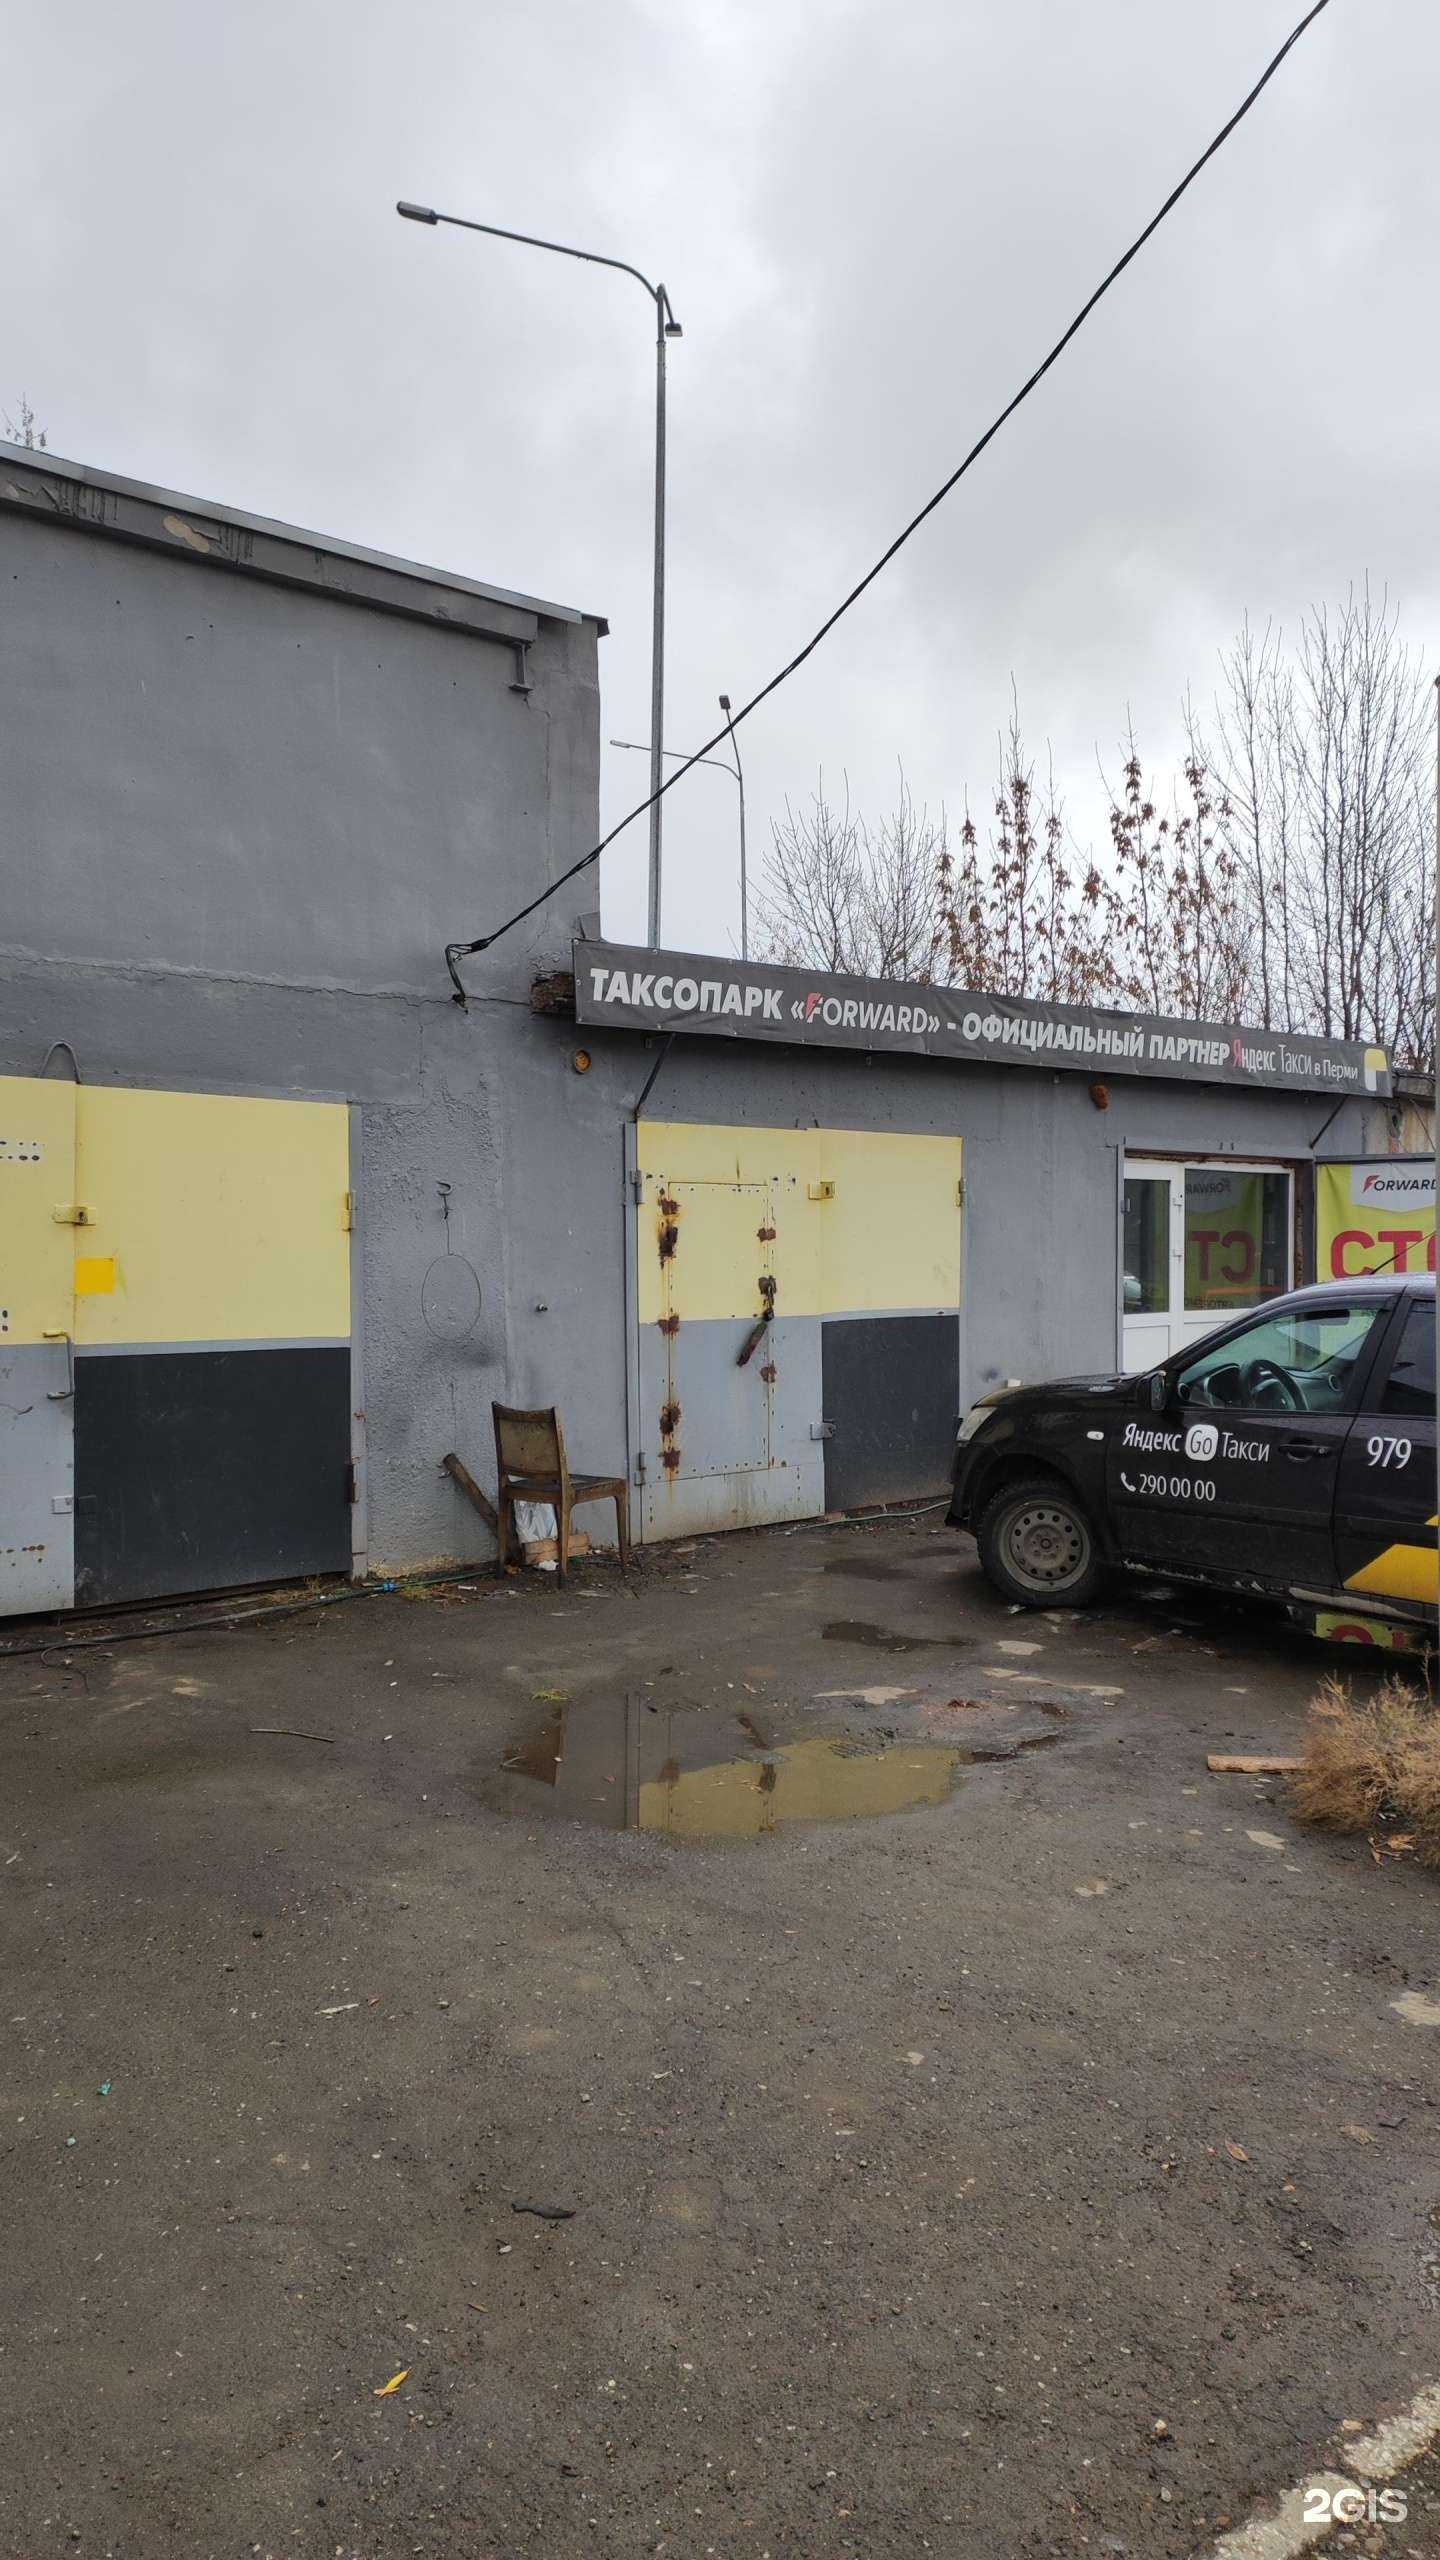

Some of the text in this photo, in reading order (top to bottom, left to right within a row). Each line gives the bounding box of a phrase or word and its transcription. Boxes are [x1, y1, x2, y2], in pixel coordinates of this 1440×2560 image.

[590, 967, 784, 1020] ТАКСОПАРК
[790, 991, 941, 1034] «FORWARD»
[962, 1012, 1146, 1059] ОФИЦИАЛЬНЫЙ
[1149, 1034, 1230, 1066] ПАРТНЕР
[1231, 1039, 1277, 1073] Яндекс
[1278, 1044, 1312, 1075] Такси
[1314, 1060, 1322, 1076] в
[1323, 1059, 1359, 1081] Перми
[1330, 1230, 1436, 1279] СТ
[1122, 1422, 1270, 1462] Яндекс Go Такси
[1367, 1436, 1412, 1469] 979
[1139, 1473, 1216, 1500] 290 00 00
